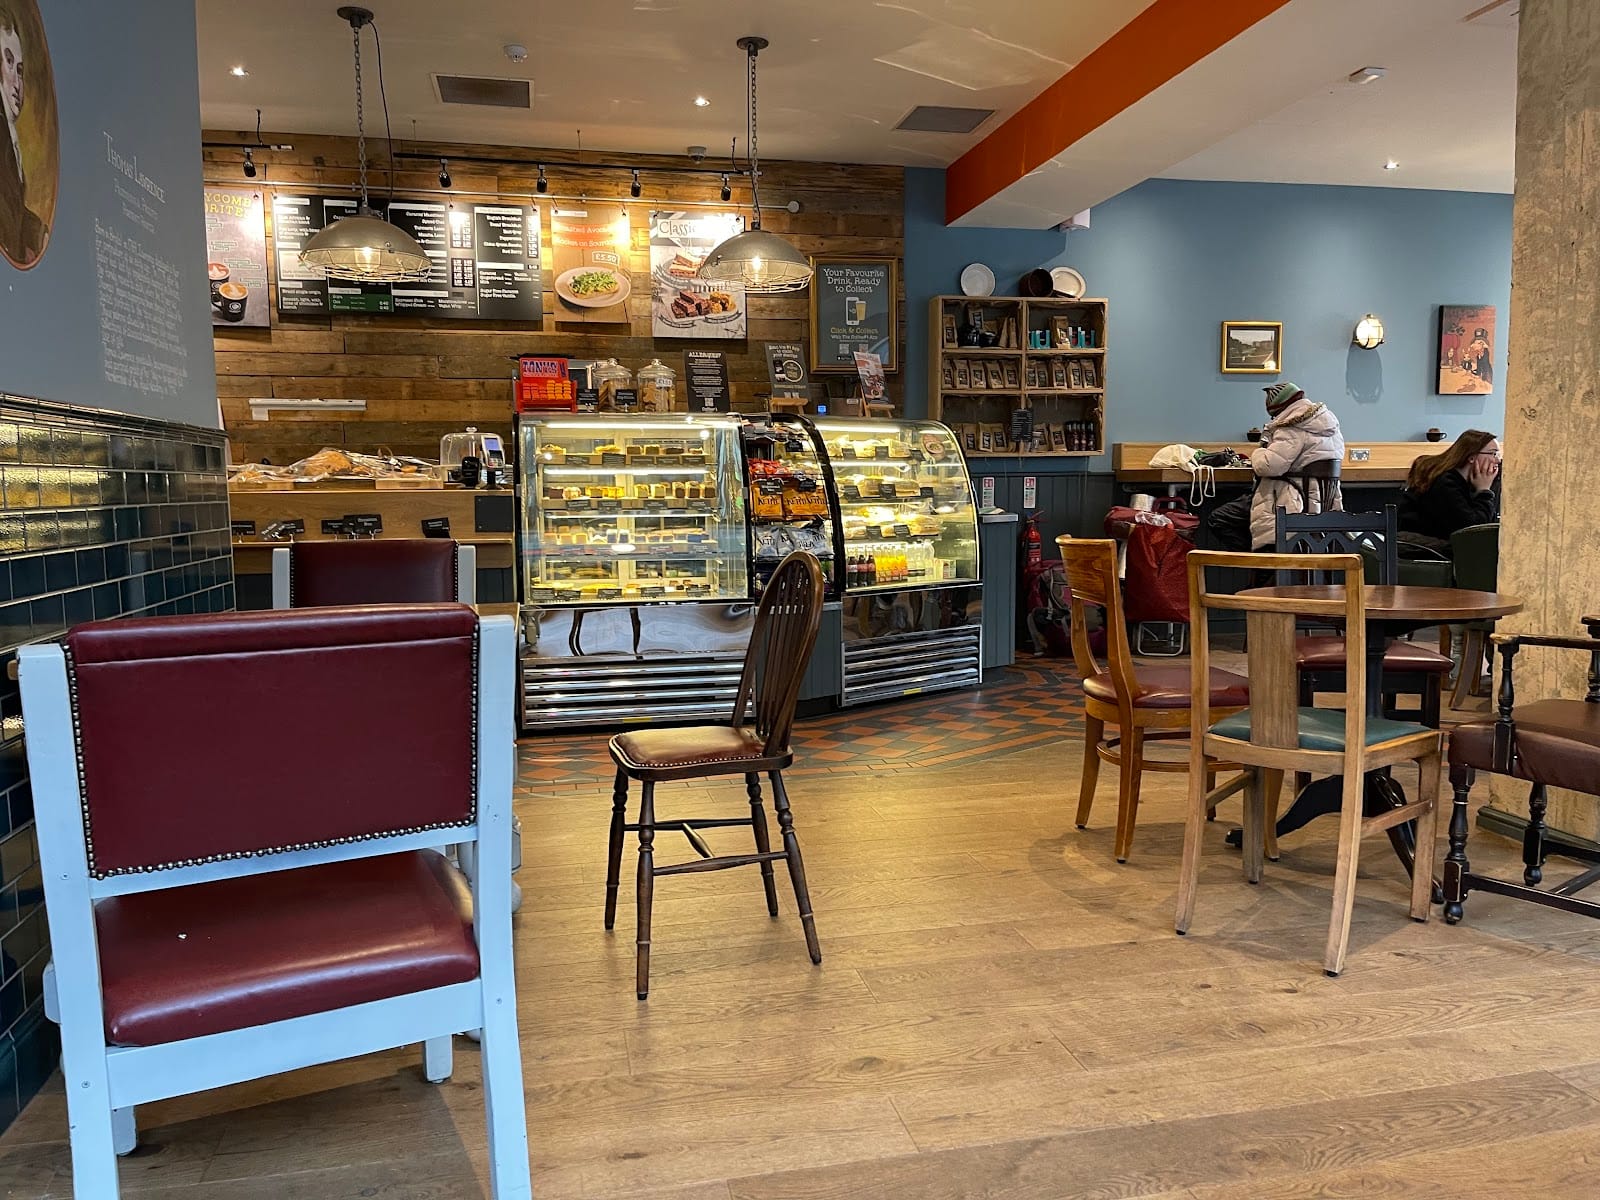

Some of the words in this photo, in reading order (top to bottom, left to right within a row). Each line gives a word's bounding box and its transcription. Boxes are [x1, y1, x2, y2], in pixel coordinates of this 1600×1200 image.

[204, 192, 252, 208] YCOMB
[823, 268, 844, 277] Your
[845, 268, 885, 277] Favourite
[827, 276, 853, 286] Drink,
[854, 277, 881, 286] Ready
[845, 285, 873, 293] Collect
